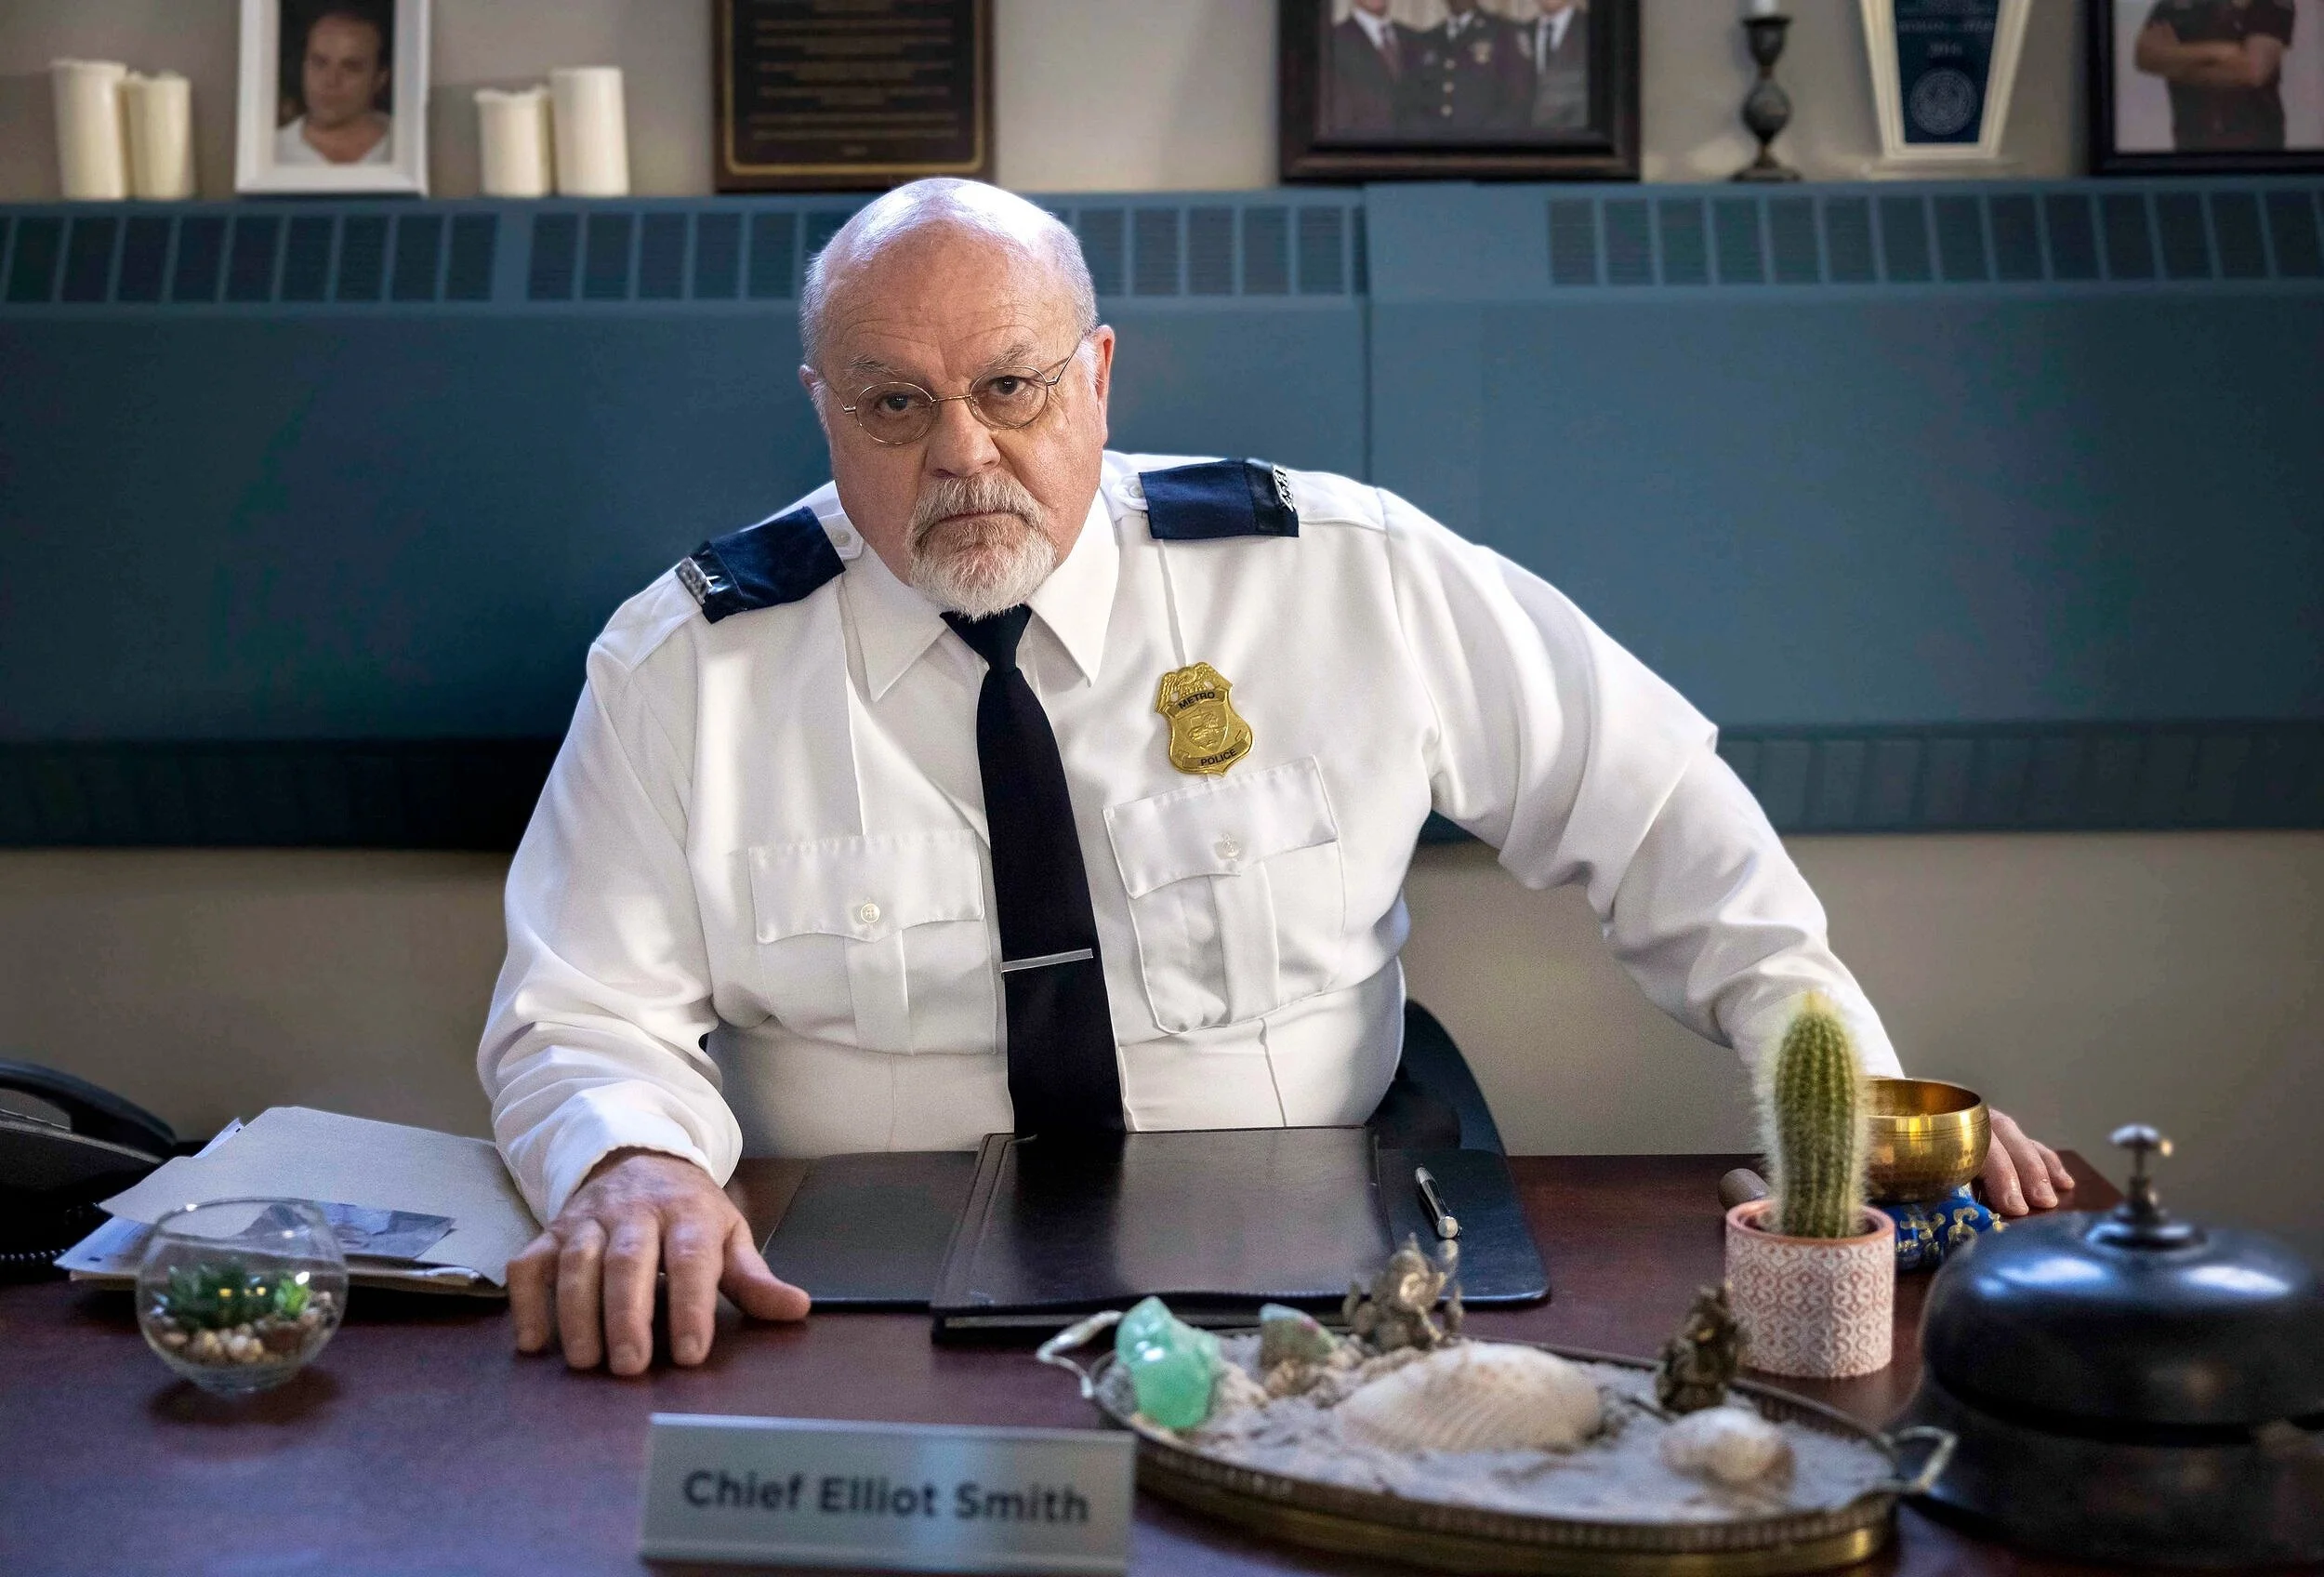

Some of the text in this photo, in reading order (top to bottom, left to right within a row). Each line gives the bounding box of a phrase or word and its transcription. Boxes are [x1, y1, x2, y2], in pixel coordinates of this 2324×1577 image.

[1178, 691, 1215, 709] METRO
[1200, 748, 1237, 766] POLICE
[682, 1470, 1091, 1524] Chief Elliot Smith
